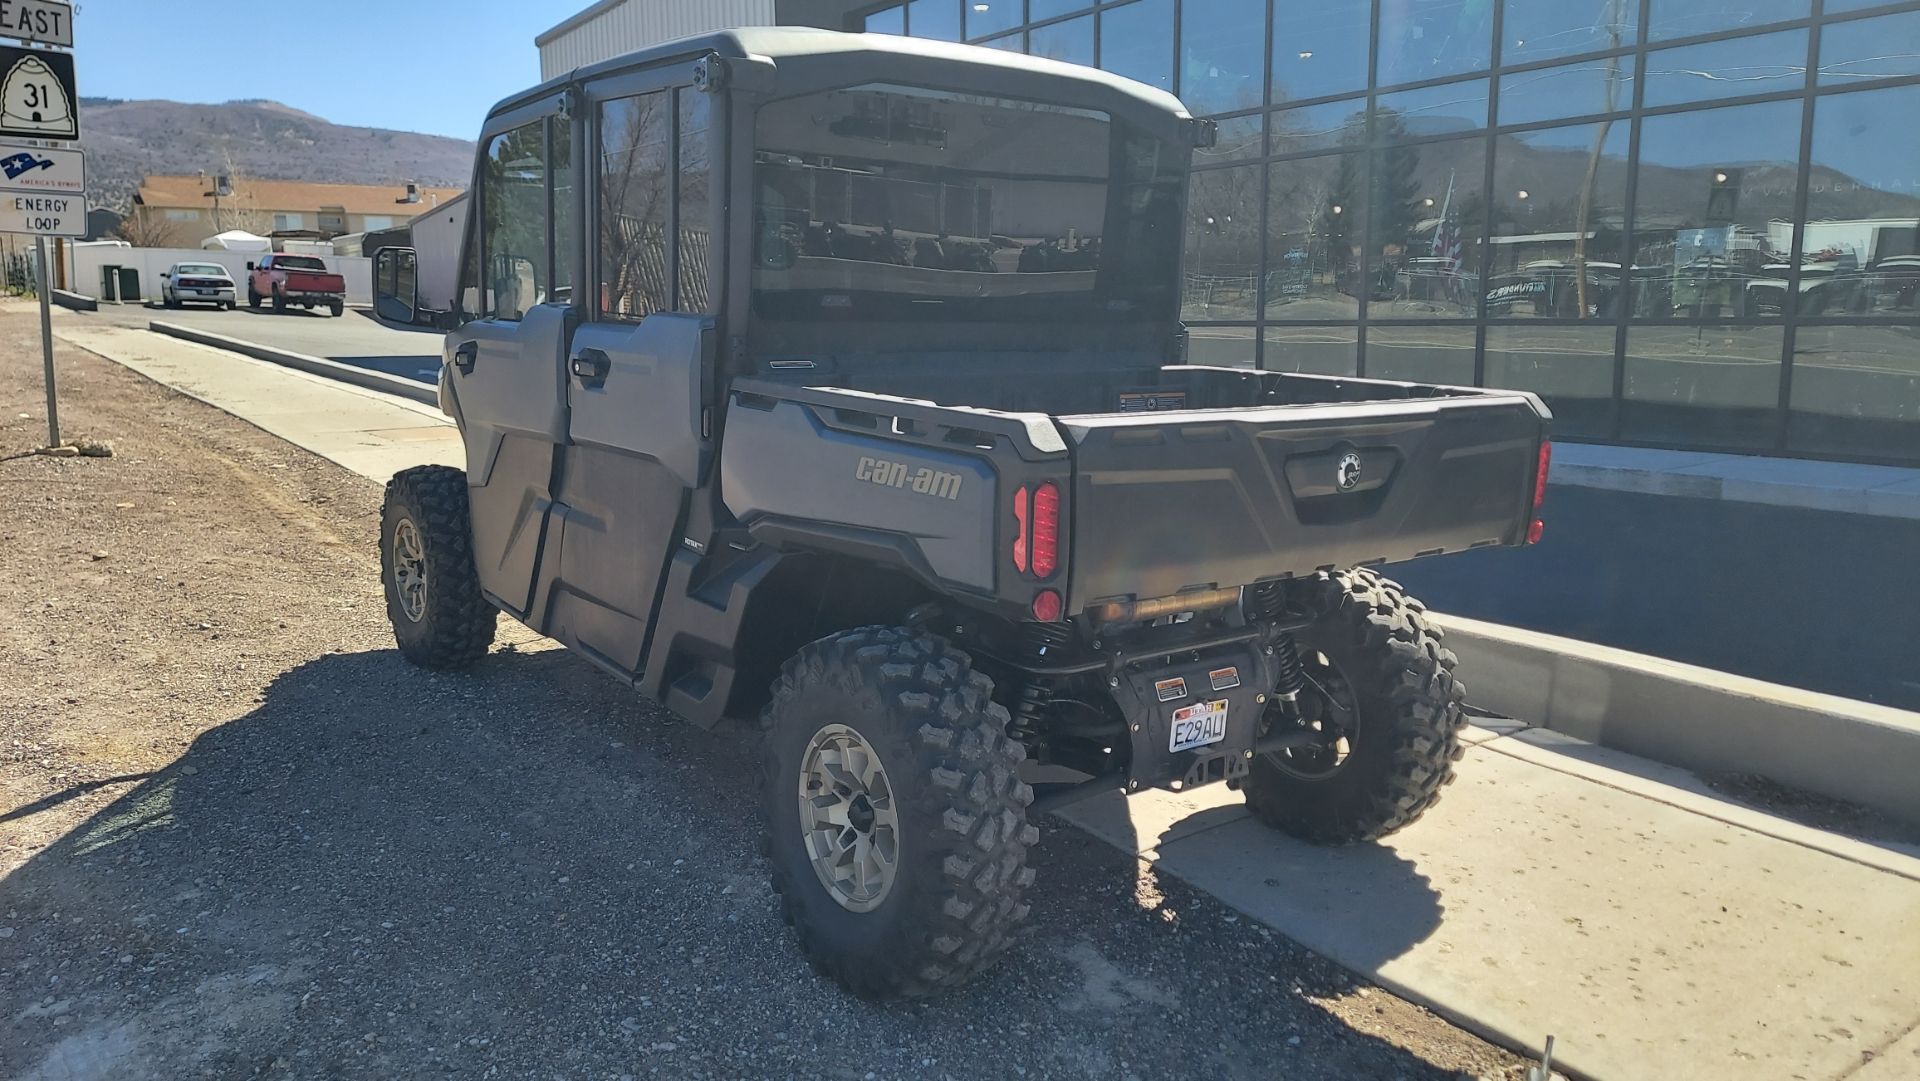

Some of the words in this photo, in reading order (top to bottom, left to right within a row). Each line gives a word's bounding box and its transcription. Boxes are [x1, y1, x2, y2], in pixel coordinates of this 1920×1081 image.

[0, 0, 61, 36] EAST
[23, 82, 48, 109] 31
[20, 179, 56, 187] AMERICA'S
[15, 197, 68, 212] ENERGY
[26, 217, 61, 230] LOOP
[855, 456, 962, 500] can-am
